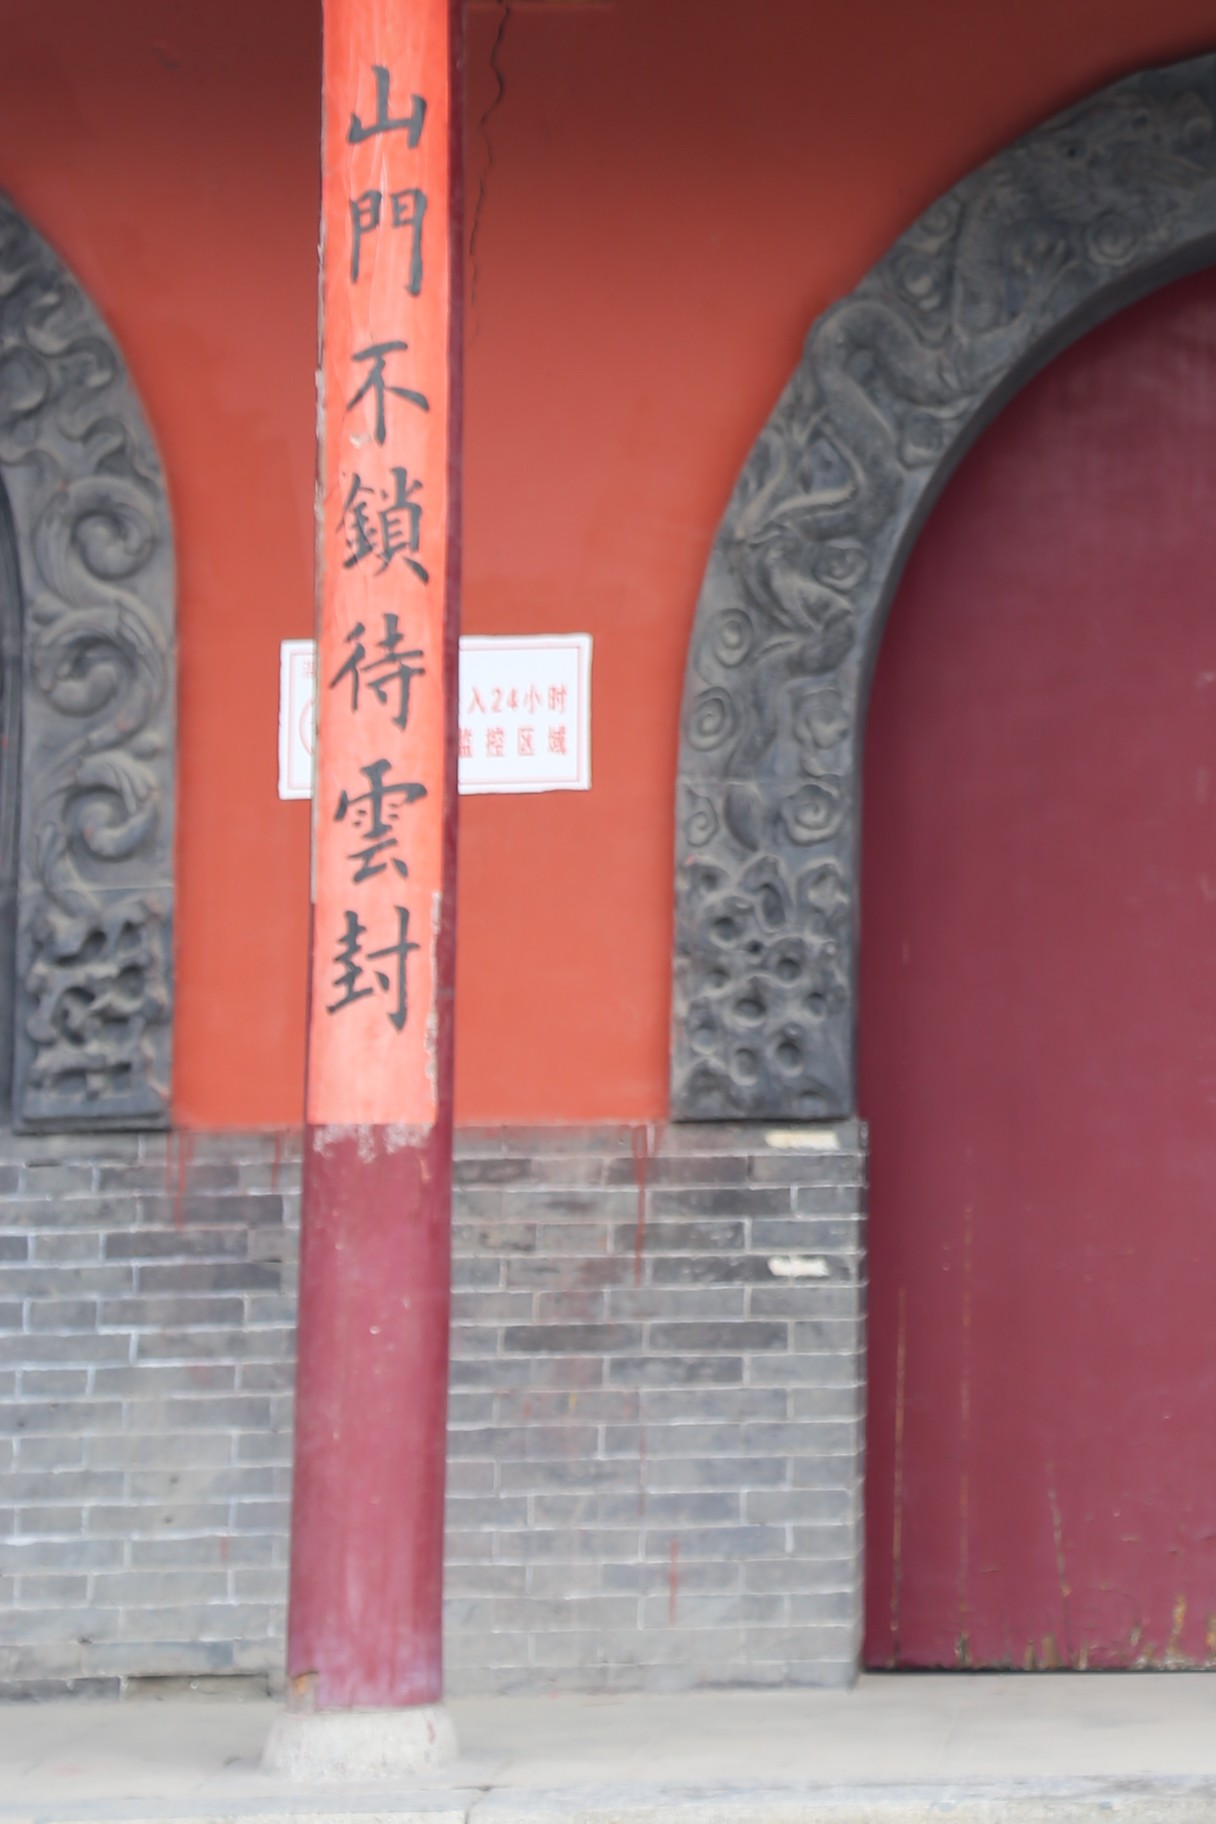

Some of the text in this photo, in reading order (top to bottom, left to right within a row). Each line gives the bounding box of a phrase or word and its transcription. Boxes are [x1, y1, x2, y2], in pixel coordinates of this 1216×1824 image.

[326, 64, 430, 1031] 山門不鎖待雲封
